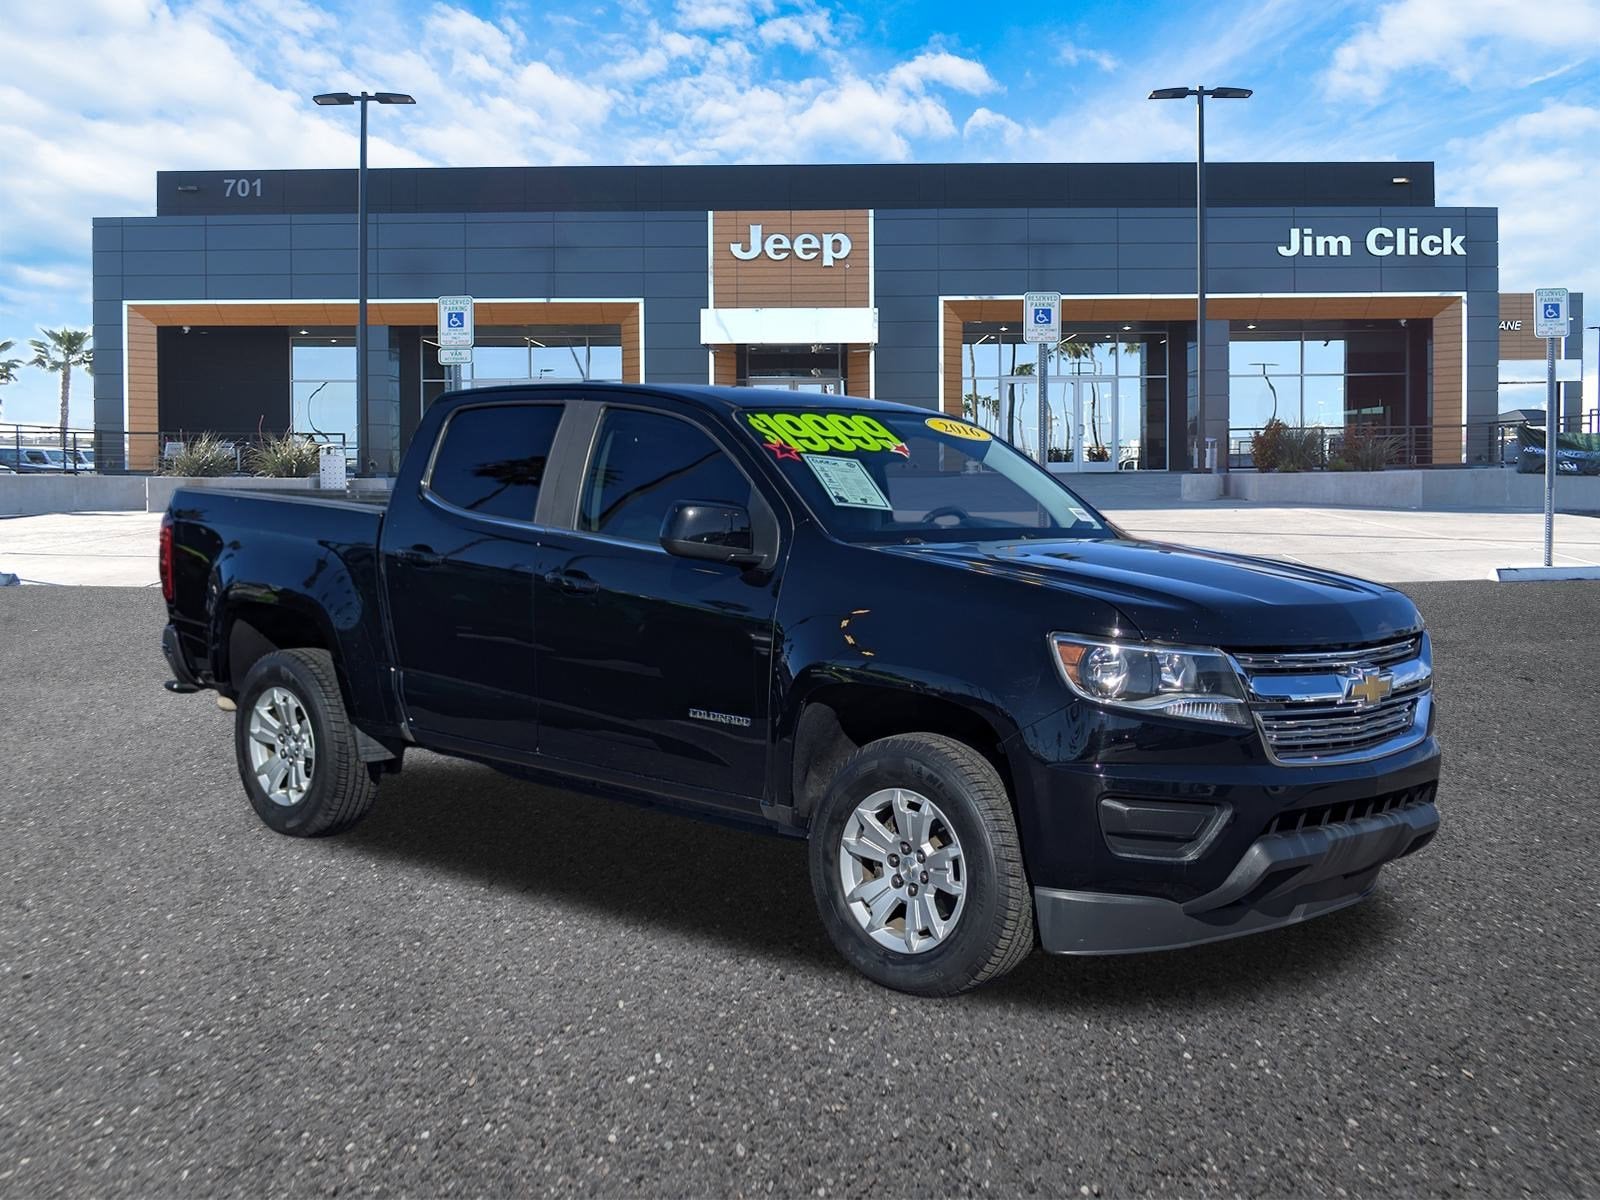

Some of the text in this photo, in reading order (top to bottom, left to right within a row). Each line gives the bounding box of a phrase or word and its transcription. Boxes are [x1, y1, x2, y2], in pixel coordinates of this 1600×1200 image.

[223, 178, 261, 197] 701
[729, 223, 851, 267] Jeep
[1277, 227, 1467, 257] Jim Click
[747, 413, 902, 452] $19999
[939, 421, 981, 437] 2016
[688, 708, 751, 727] COLORADO
